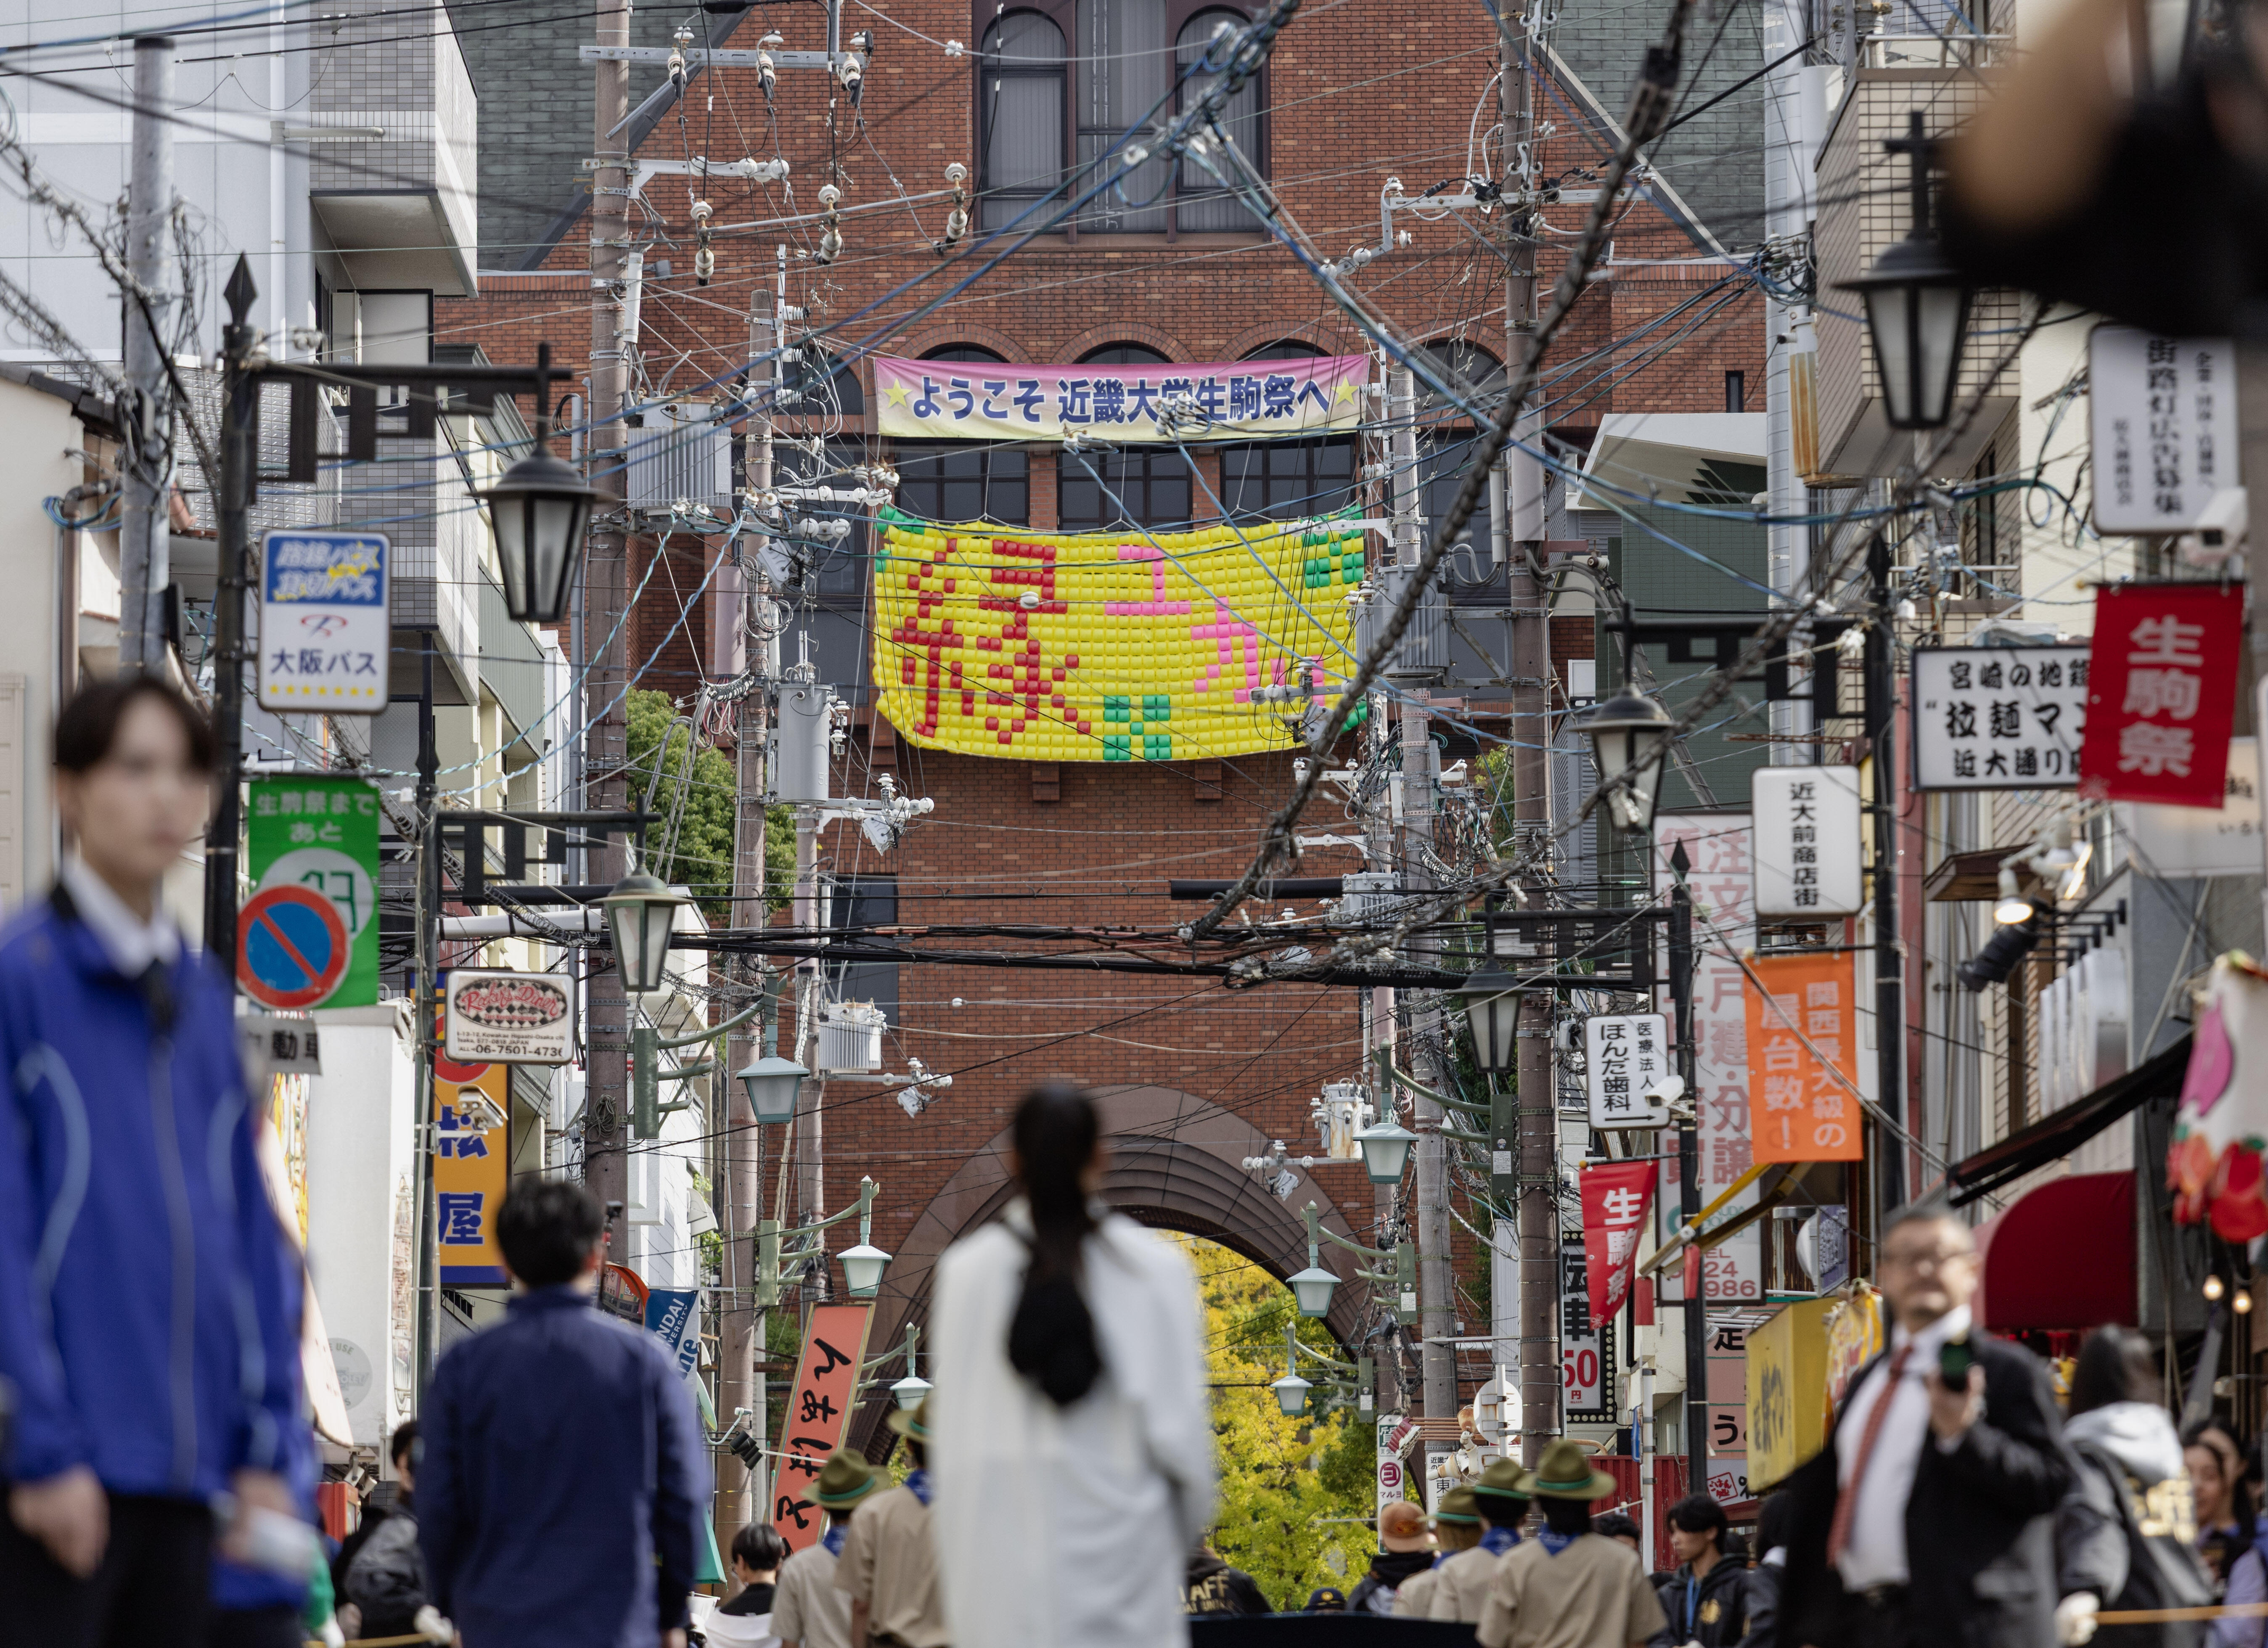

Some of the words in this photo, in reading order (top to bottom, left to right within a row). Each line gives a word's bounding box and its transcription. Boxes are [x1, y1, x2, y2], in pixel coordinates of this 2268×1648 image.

[912, 376, 1045, 422] ようこそ
[1057, 374, 1329, 423] 近畿大学生駒祭へ
[270, 648, 377, 676] 大阪バス
[2118, 614, 2204, 778] 生駒祭
[255, 790, 376, 816] 生駒祭まで
[289, 820, 343, 844] あと
[1790, 782, 1818, 907] 近大前商店街
[515, 985, 559, 1017] Diner
[1601, 1024, 1631, 1112] ほんだ歯科
[1638, 1022, 1655, 1090] 医療法人
[1602, 1187, 1643, 1306] 生駒祭
[1705, 1248, 1731, 1258] EL
[1704, 1280, 1756, 1297] 986
[1572, 1390, 1581, 1399] 円
[1714, 1414, 1746, 1446] う
